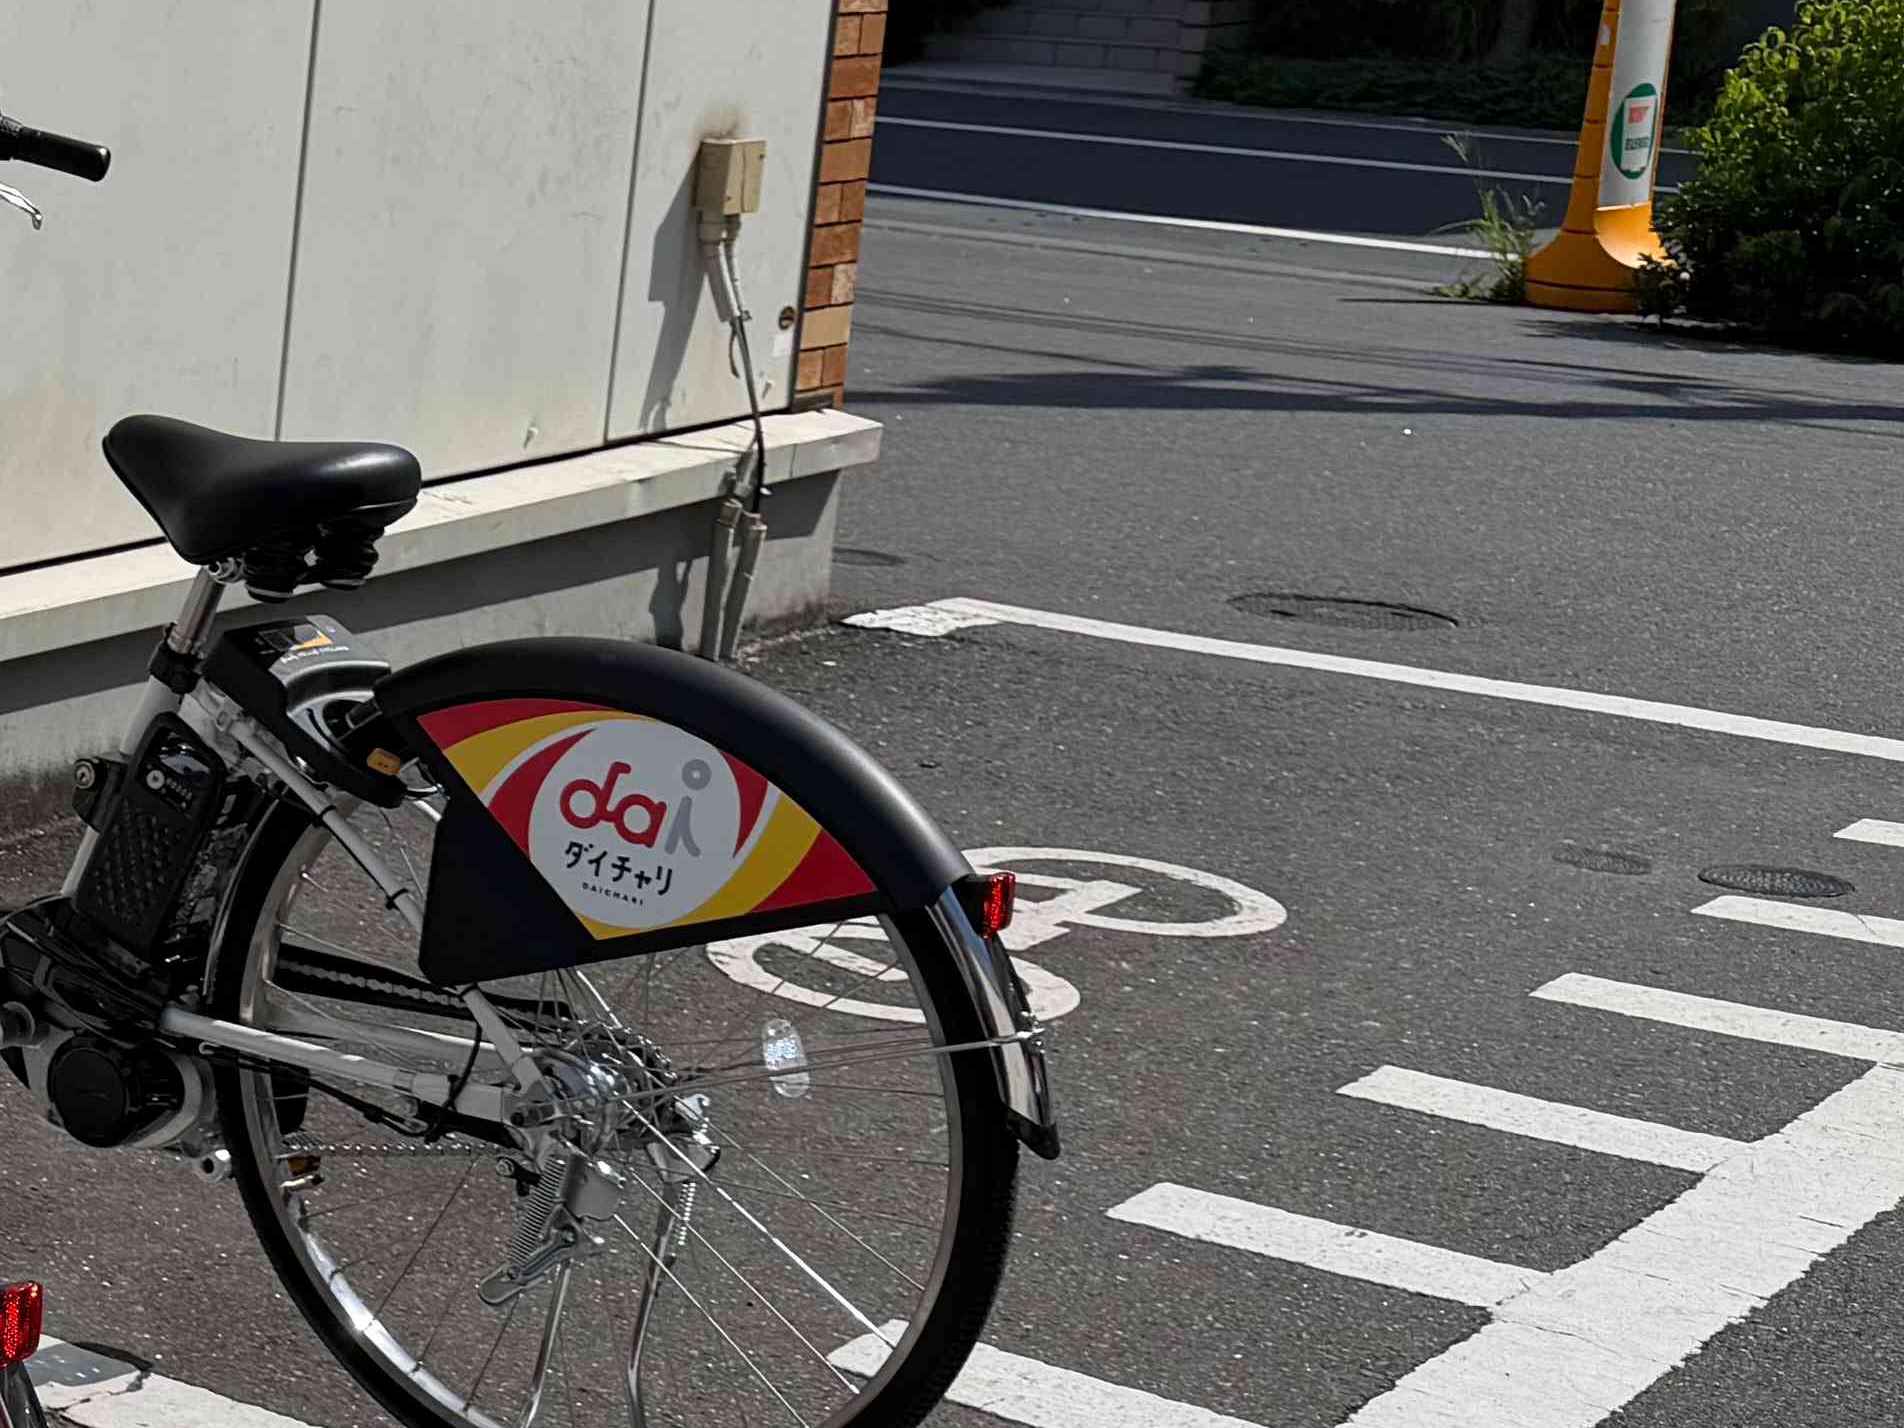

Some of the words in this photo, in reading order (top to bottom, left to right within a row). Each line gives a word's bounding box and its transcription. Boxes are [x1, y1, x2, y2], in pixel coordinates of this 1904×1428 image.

[559, 758, 712, 858] dai
[564, 839, 674, 896] ダイチャリ
[581, 882, 645, 907] DAICHARI
